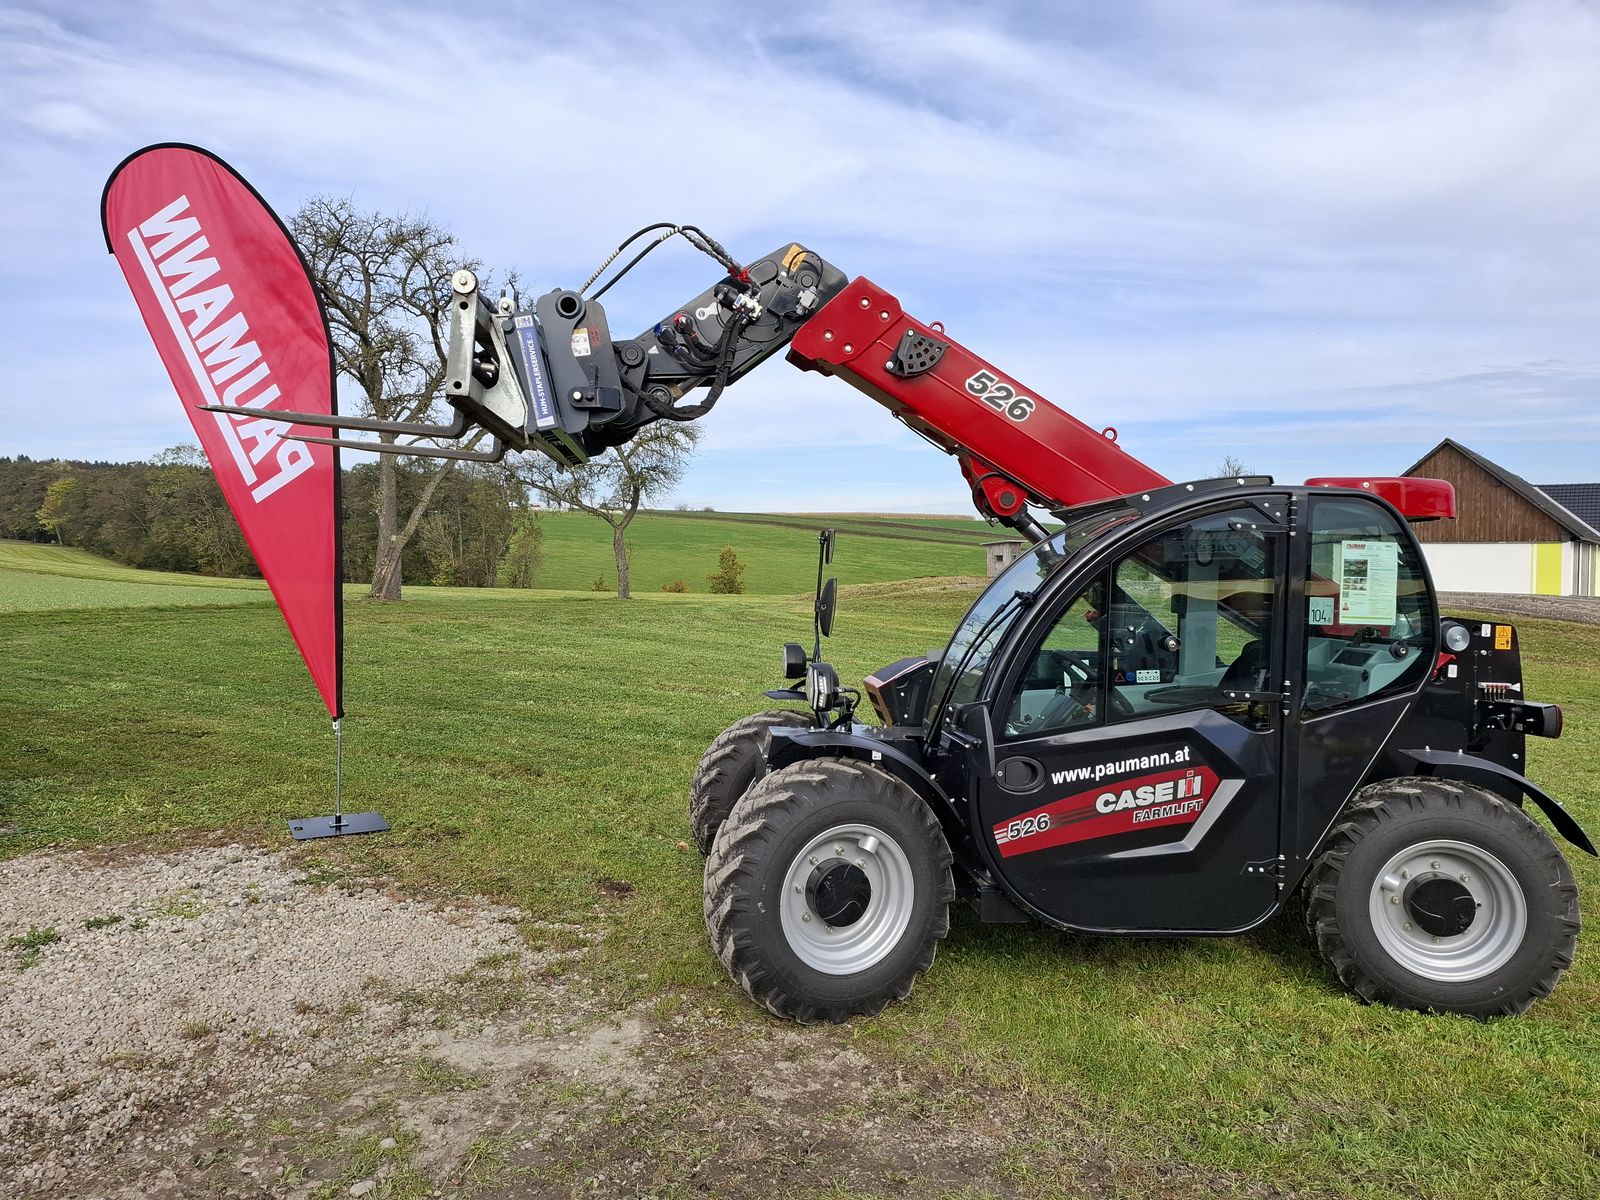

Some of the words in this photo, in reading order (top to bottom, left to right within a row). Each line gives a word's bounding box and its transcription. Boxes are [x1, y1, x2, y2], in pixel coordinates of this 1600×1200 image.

[965, 368, 1036, 422] 526
[1311, 609, 1327, 623] 104
[1051, 745, 1190, 785] www.paumann.at
[1095, 781, 1173, 814] CASE
[1133, 799, 1203, 823] FARMLIFT
[1007, 813, 1050, 840] 526
